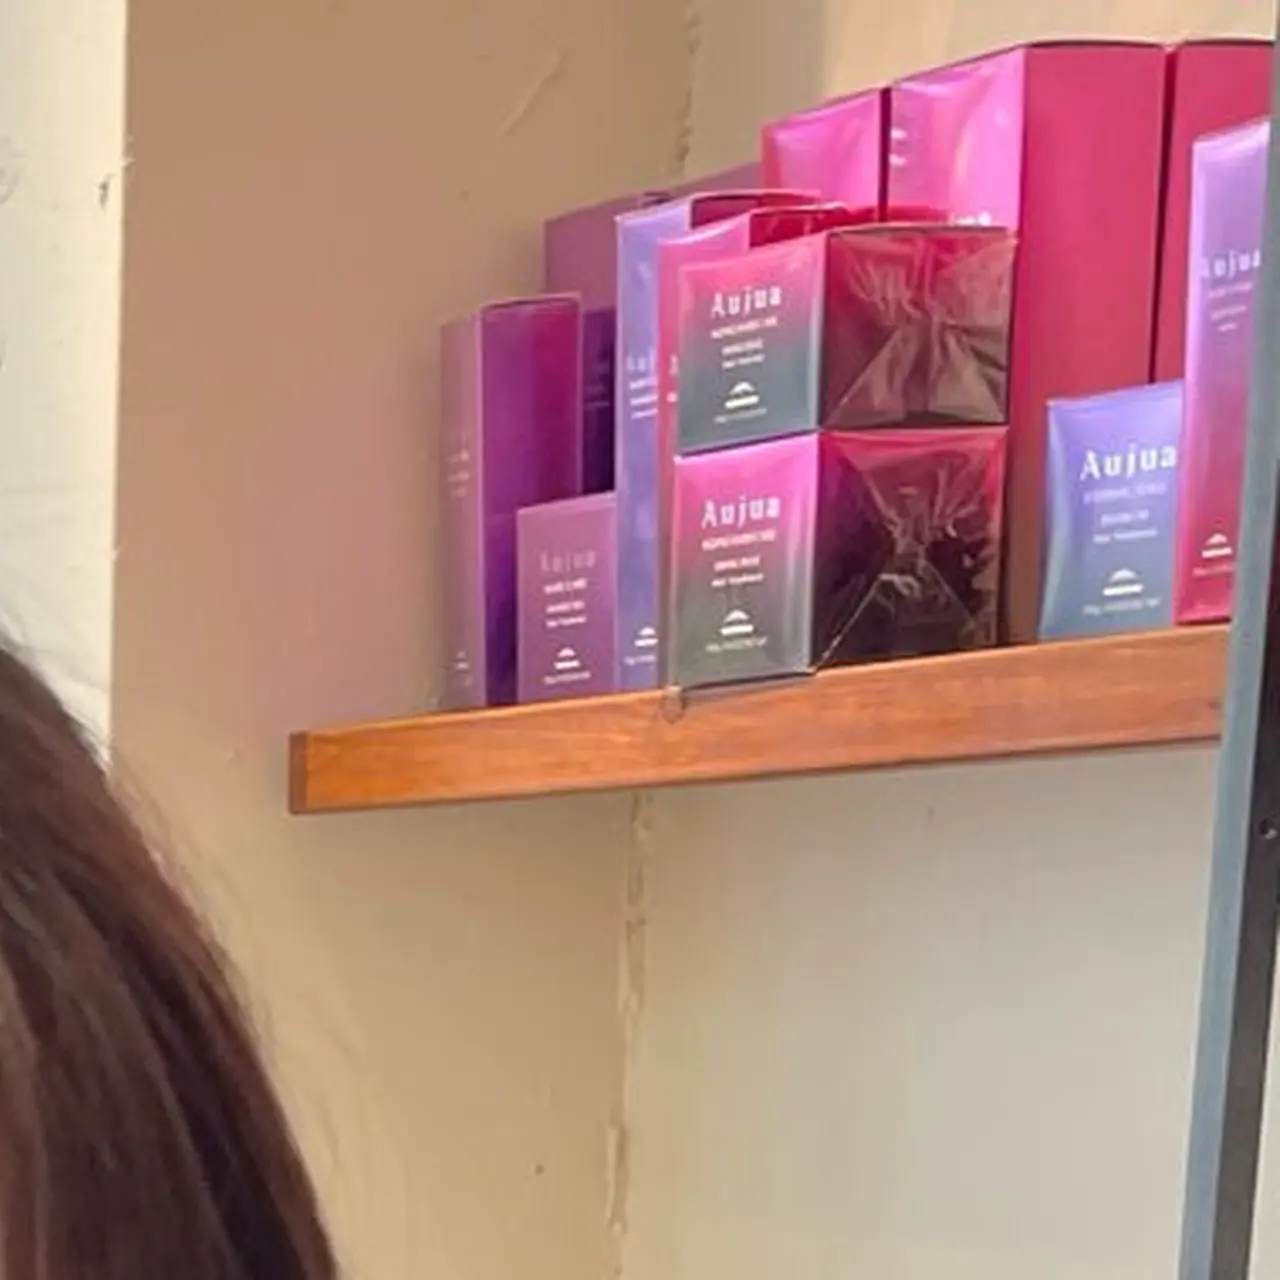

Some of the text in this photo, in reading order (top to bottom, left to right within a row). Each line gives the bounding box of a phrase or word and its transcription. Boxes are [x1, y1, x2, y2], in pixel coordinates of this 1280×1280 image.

[710, 285, 782, 318] Aujua
[1079, 444, 1178, 480] Aujua
[701, 495, 781, 529] Aujua
